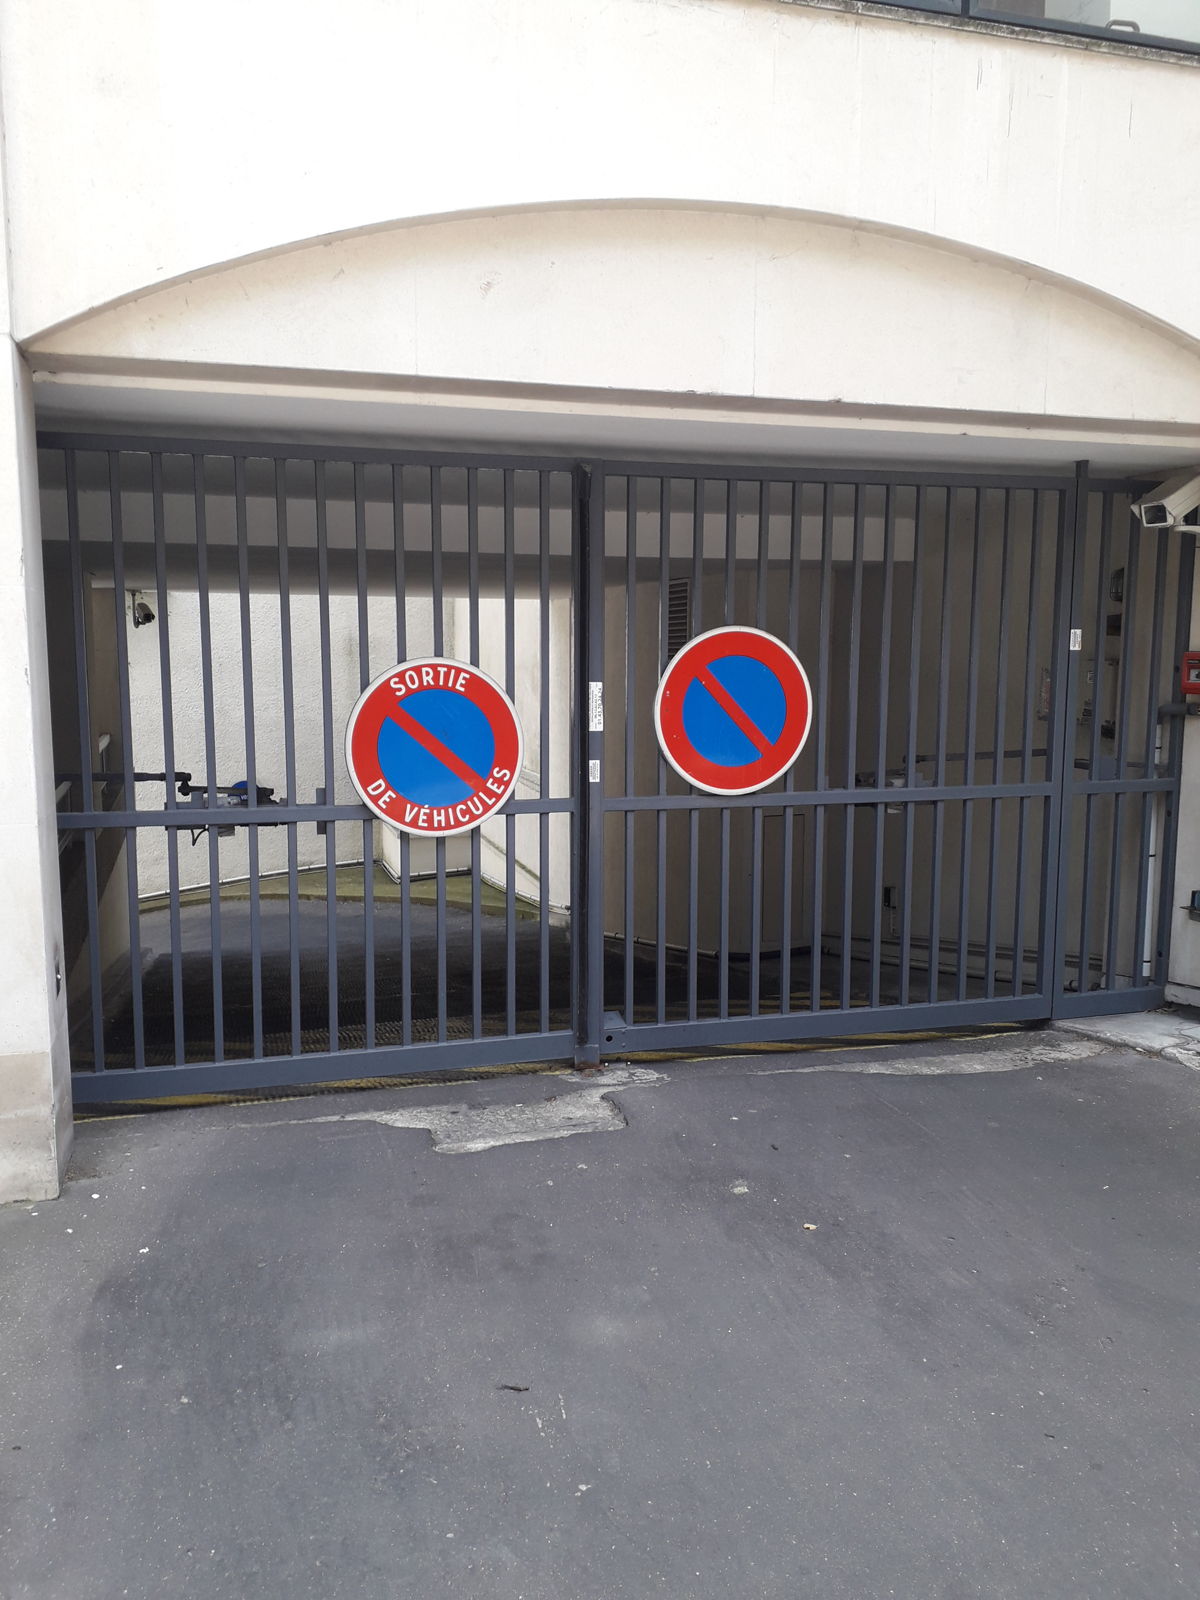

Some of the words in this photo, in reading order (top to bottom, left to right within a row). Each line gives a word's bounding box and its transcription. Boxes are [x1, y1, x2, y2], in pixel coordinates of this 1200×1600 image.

[389, 667, 470, 696] SORTIE
[366, 779, 396, 809] DE
[404, 767, 511, 828] VÉHICULES
